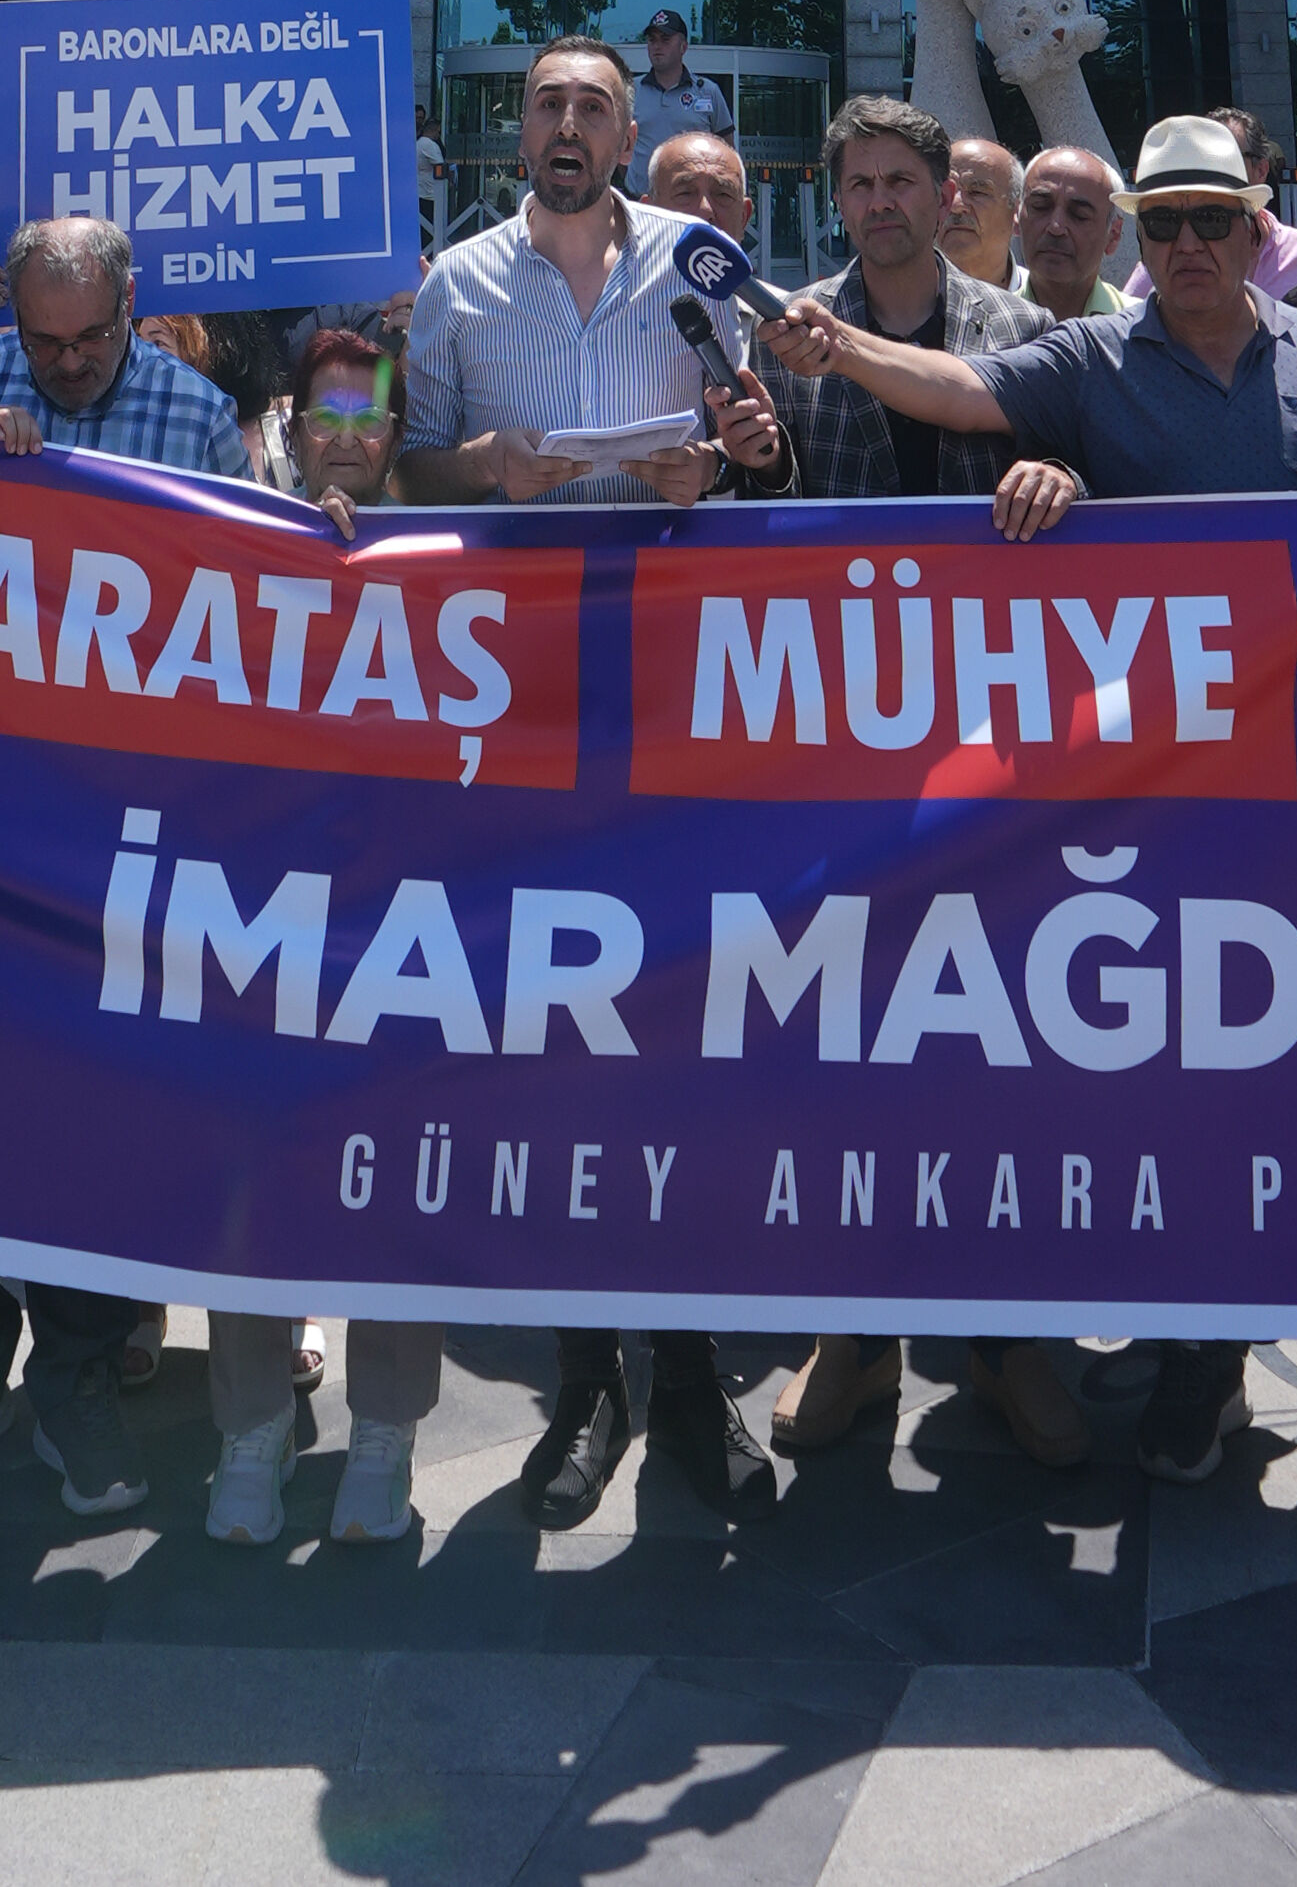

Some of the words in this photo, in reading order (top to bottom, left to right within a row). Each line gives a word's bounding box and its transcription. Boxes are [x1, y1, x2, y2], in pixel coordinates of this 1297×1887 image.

[58, 23, 253, 62] BARONLARA
[260, 11, 349, 53] DEĞİL
[57, 77, 352, 154] HALK'A
[52, 153, 356, 232] HİZMET
[162, 243, 256, 285] EDİN
[691, 557, 1235, 751] MÜHYE
[98, 807, 645, 1056] İMAR
[339, 1123, 677, 1223] GÜNEY
[765, 1148, 1165, 1231] ANKARA
